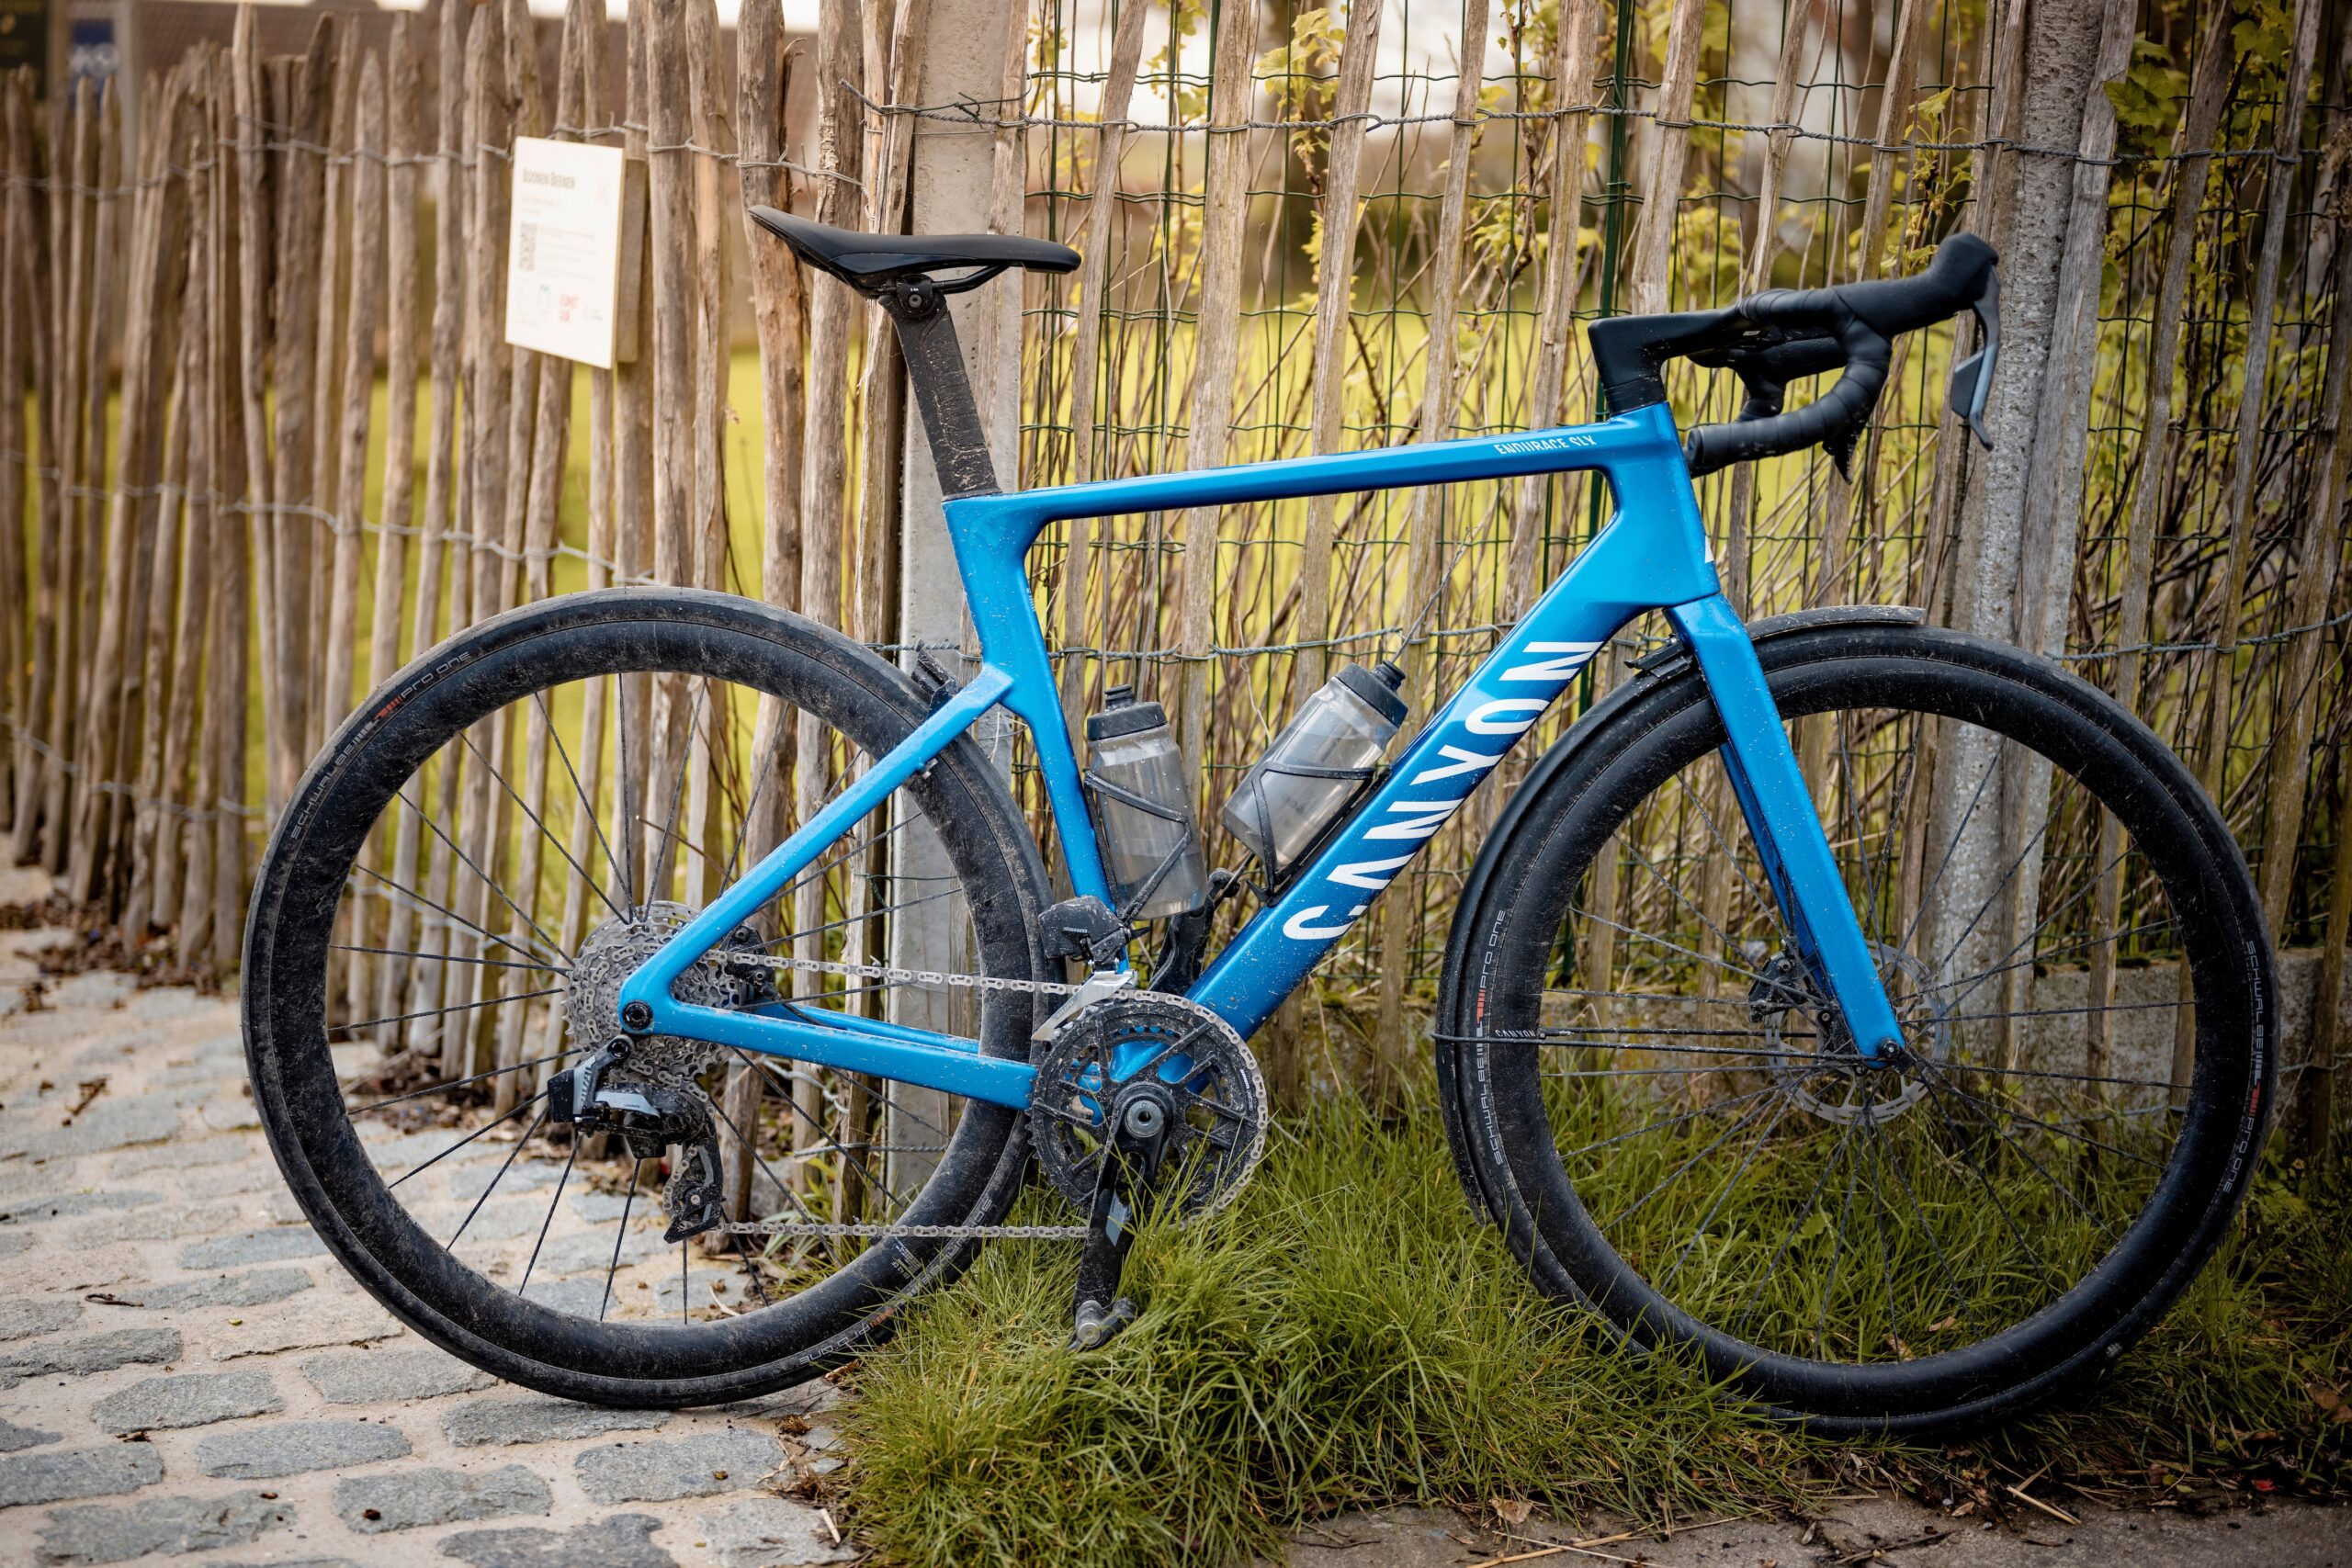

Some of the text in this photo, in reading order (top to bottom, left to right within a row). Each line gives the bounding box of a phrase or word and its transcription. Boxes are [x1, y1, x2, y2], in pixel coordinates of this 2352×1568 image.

[1493, 434, 1598, 455] ENDURACE SLX
[290, 744, 355, 840] SCHWALBE
[1283, 641, 1604, 941] CANYON
[1494, 1029, 1536, 1038] CANYON
[2246, 940, 2264, 1049] SCHWALBE
[1476, 1057, 1503, 1166] SCHWALBE
